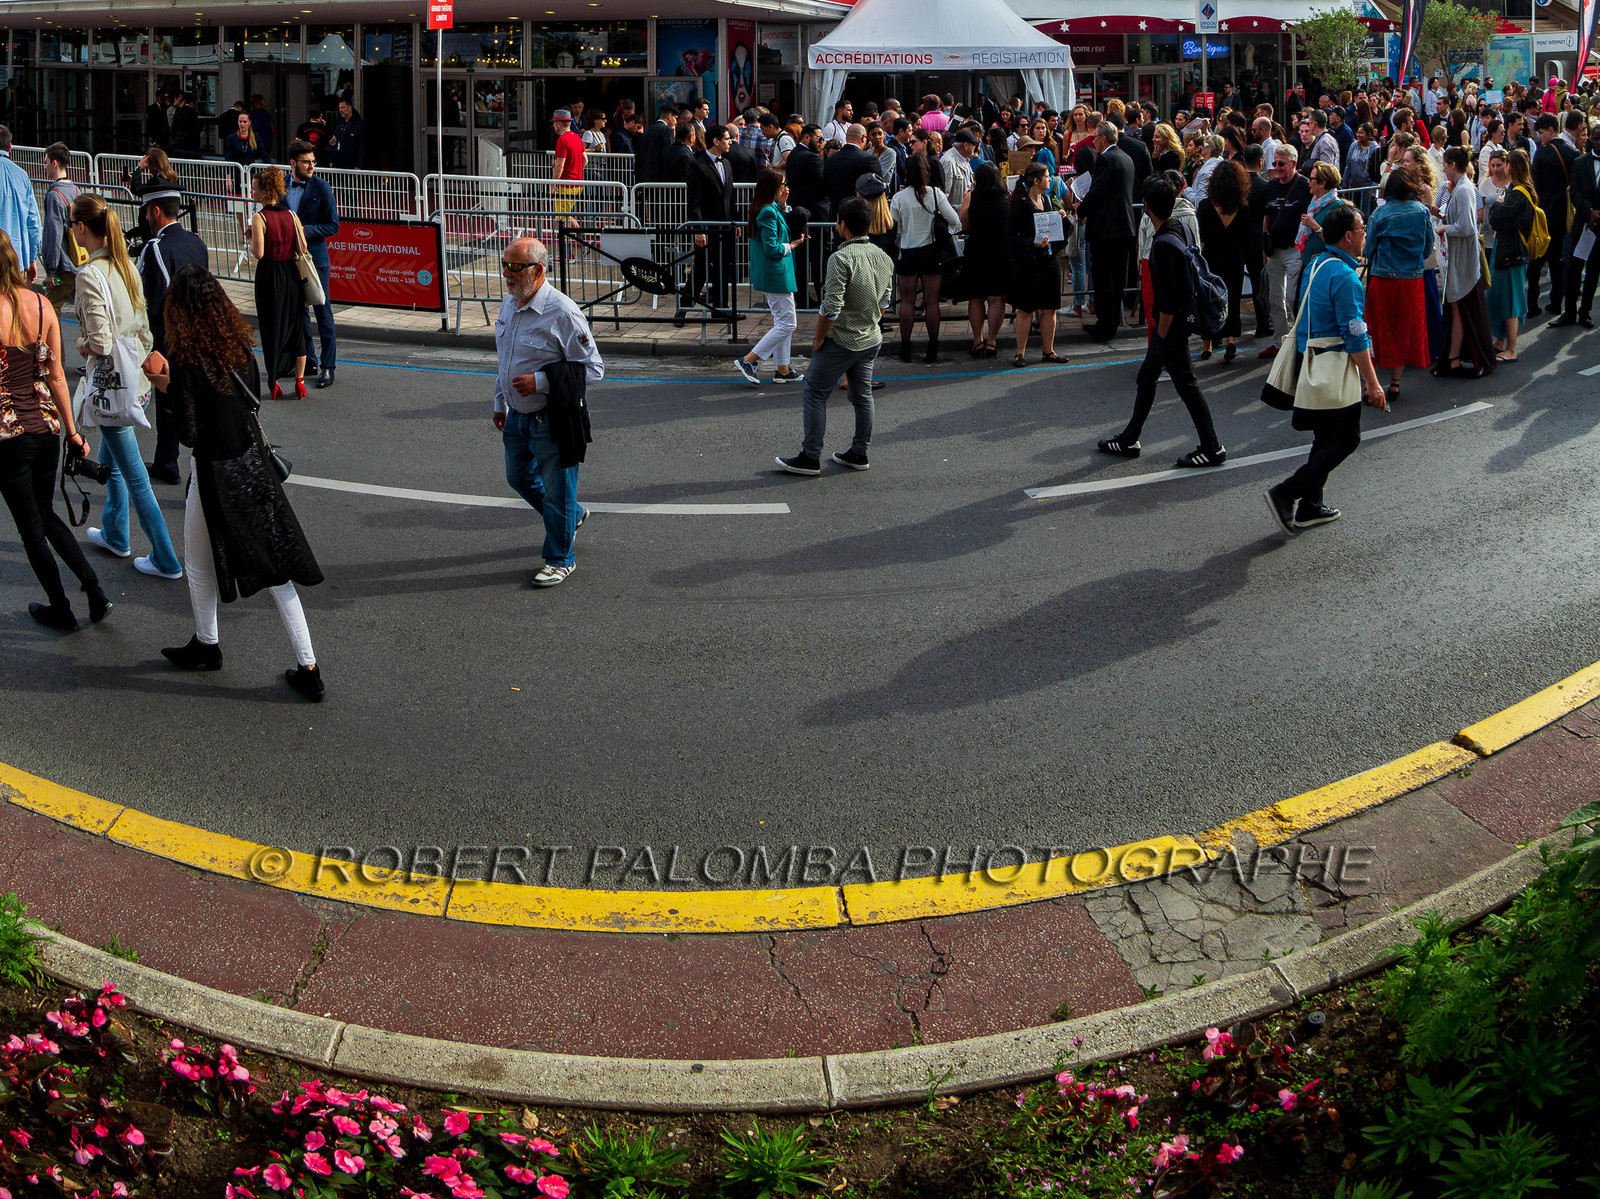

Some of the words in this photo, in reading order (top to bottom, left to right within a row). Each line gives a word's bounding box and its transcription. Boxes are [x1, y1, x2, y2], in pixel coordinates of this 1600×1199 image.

[815, 50, 934, 65] ACCRÉDITATIONS
[972, 51, 1065, 64] REGISTRATION
[326, 241, 346, 251] AGE
[348, 242, 421, 256] INTERNATIONAL
